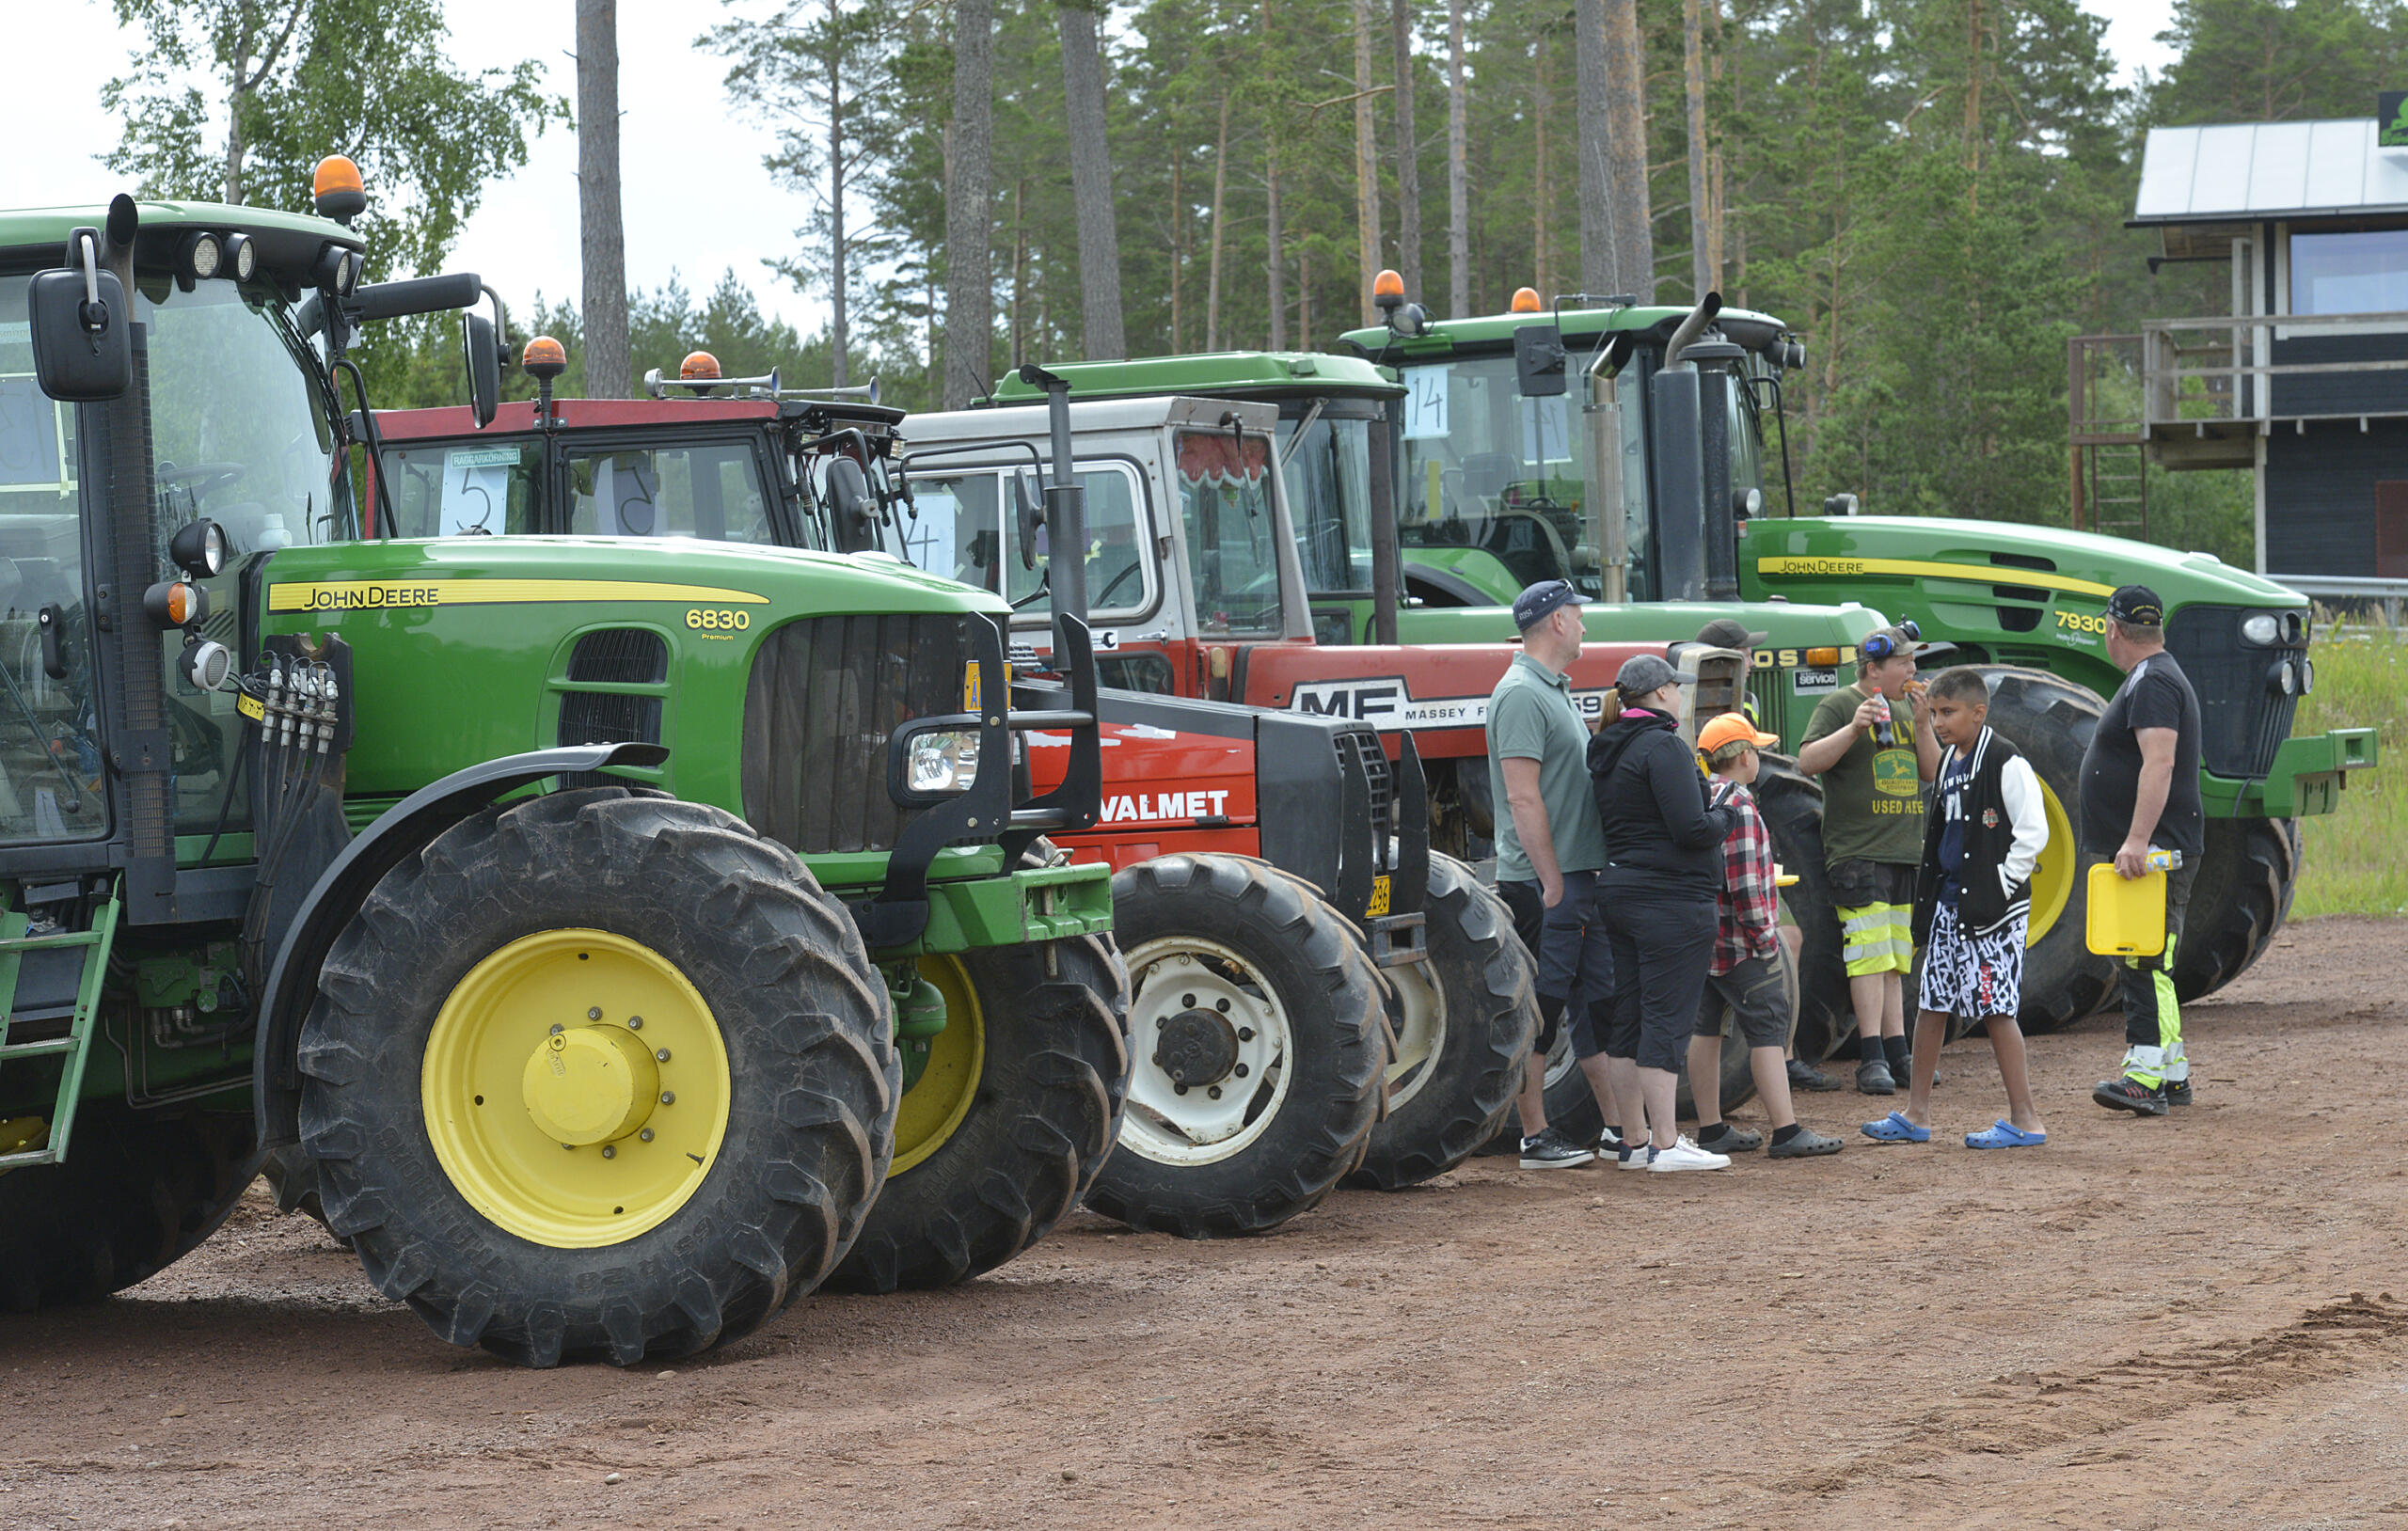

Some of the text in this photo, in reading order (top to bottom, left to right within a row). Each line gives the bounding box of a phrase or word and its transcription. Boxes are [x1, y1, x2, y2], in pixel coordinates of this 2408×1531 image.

[1414, 376, 1443, 429] 14
[455, 468, 491, 531] 5
[906, 517, 939, 571] 4
[1780, 560, 1864, 573] JOHN DEERE
[304, 586, 439, 608] JOHN DEERE
[685, 608, 751, 631] 6830
[2054, 609, 2106, 635] 7930
[1799, 673, 1835, 685] service
[1301, 687, 1398, 720] MF
[1405, 707, 1465, 720] MASSEY
[1100, 790, 1228, 822] VALMET
[1872, 799, 1903, 814] USED
